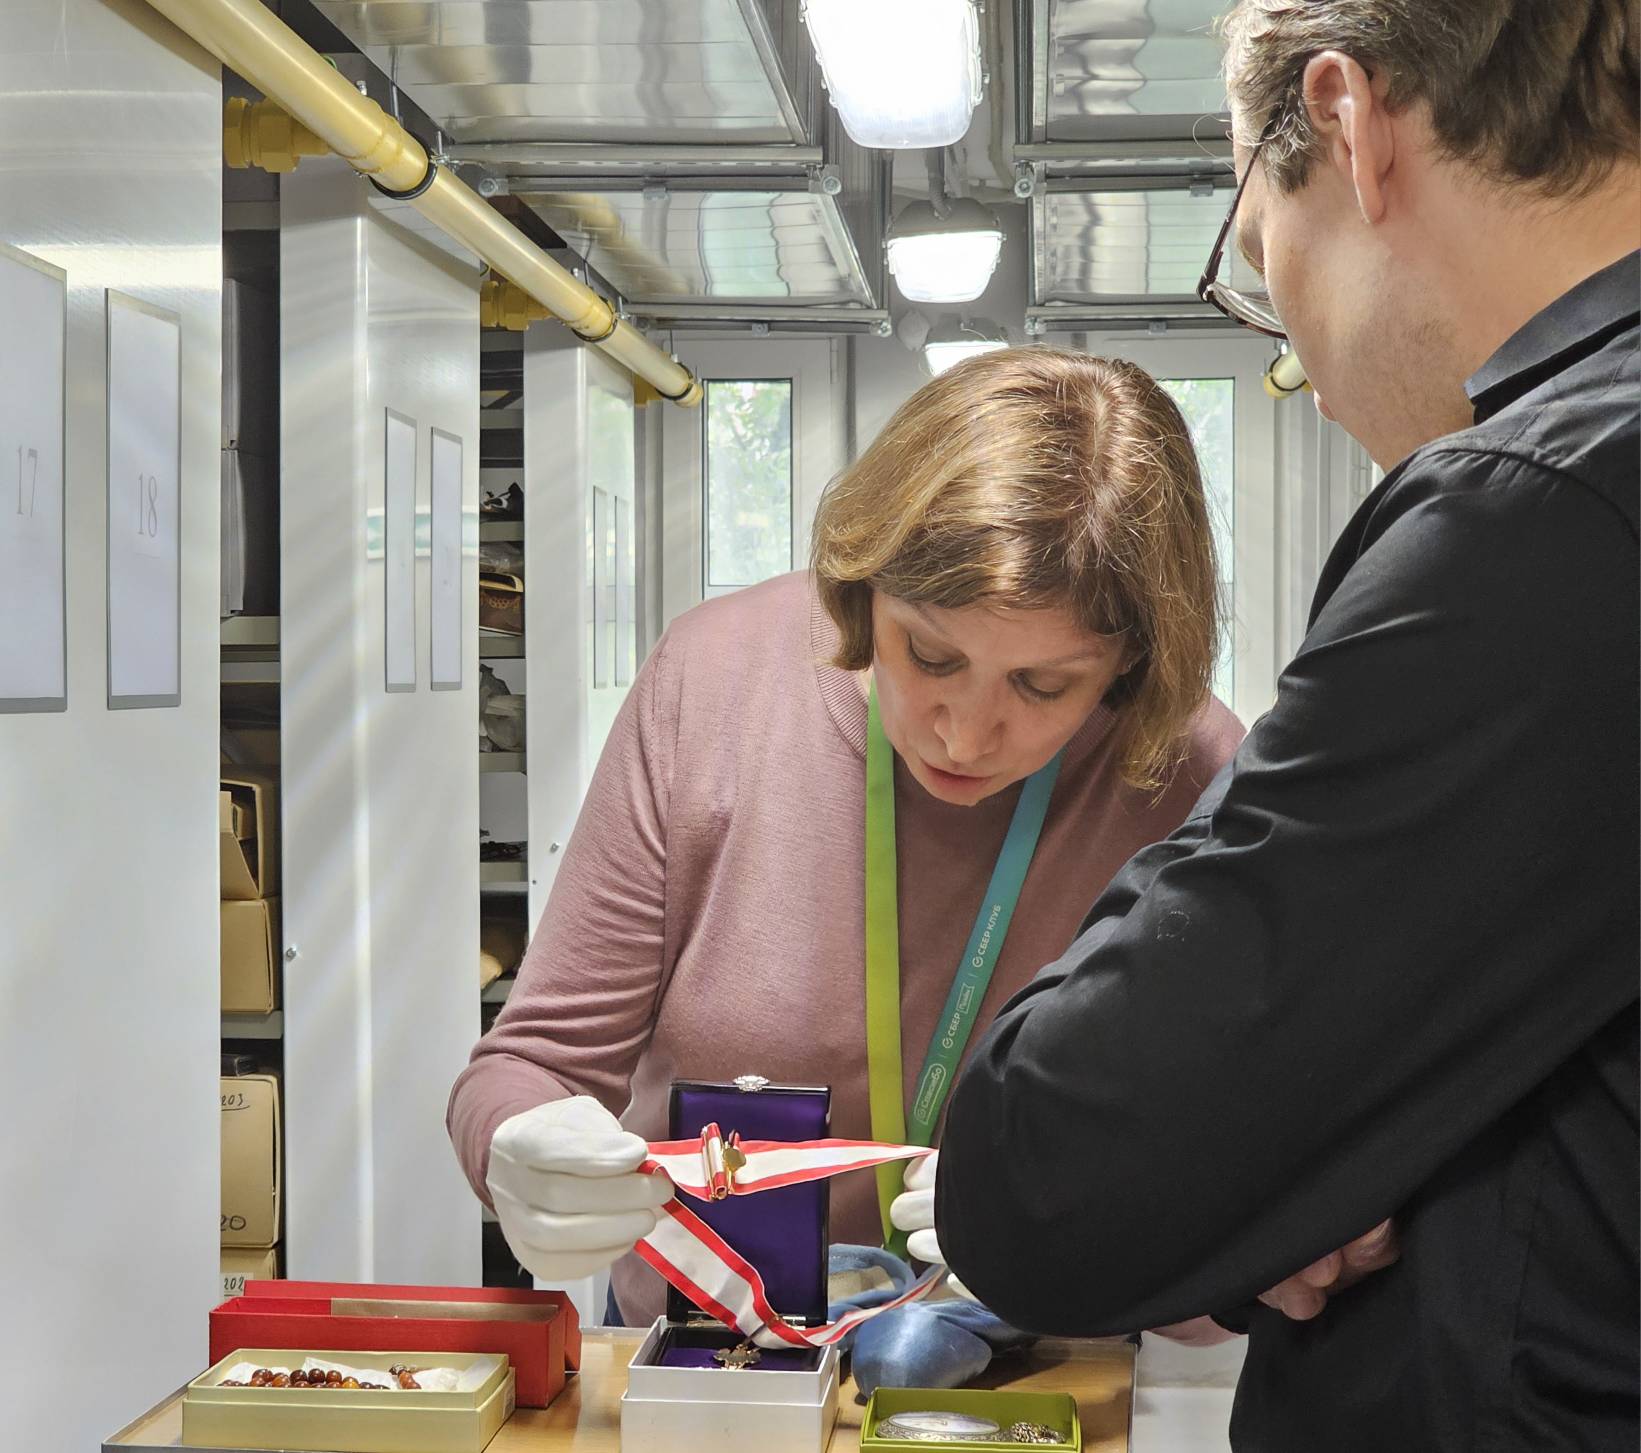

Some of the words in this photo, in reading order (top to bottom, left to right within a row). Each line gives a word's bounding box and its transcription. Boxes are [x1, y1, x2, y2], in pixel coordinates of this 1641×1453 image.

[17, 444, 38, 519] 17
[137, 472, 158, 538] 18
[948, 1012, 960, 1037] СБЕР
[978, 930, 991, 955] СБЕР
[987, 904, 1001, 930] КЛУБ
